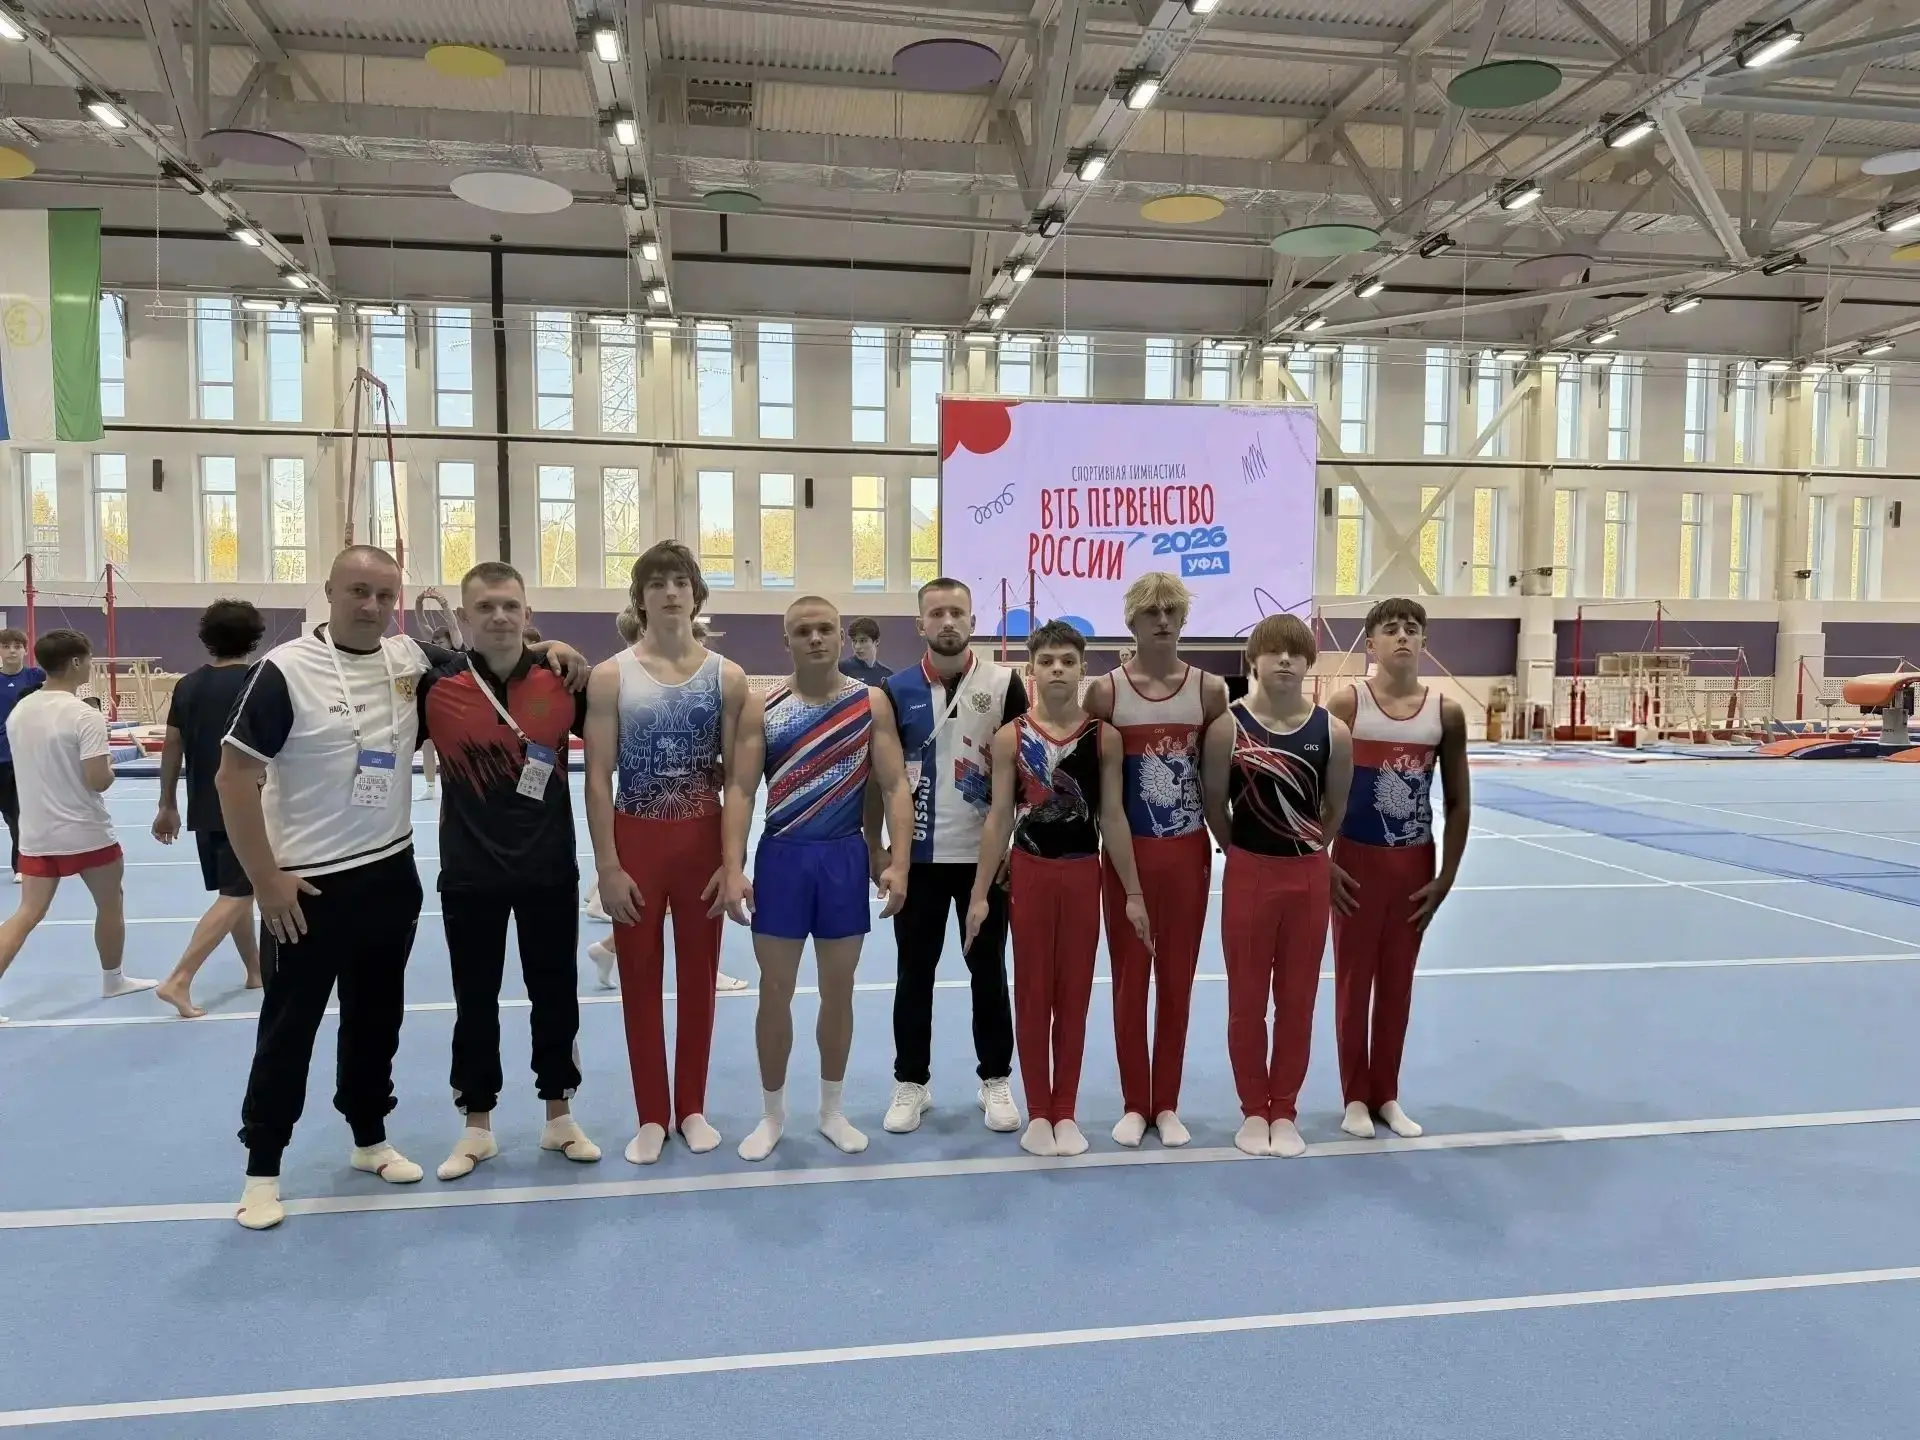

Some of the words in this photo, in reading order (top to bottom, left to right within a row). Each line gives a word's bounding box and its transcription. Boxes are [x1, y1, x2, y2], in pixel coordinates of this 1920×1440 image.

[1071, 465, 1127, 482] СПОРТИВНАЯ
[1129, 463, 1186, 480] ГИМНАСТИКА
[1041, 488, 1080, 530] ВТБ
[1087, 484, 1214, 527] ПЕРВЕНСТВО
[1028, 532, 1125, 580] РОССИИ
[1151, 525, 1228, 556] 2026
[1187, 556, 1224, 573] УФА
[1303, 743, 1320, 752] GKS
[912, 776, 931, 842] RUSSIA
